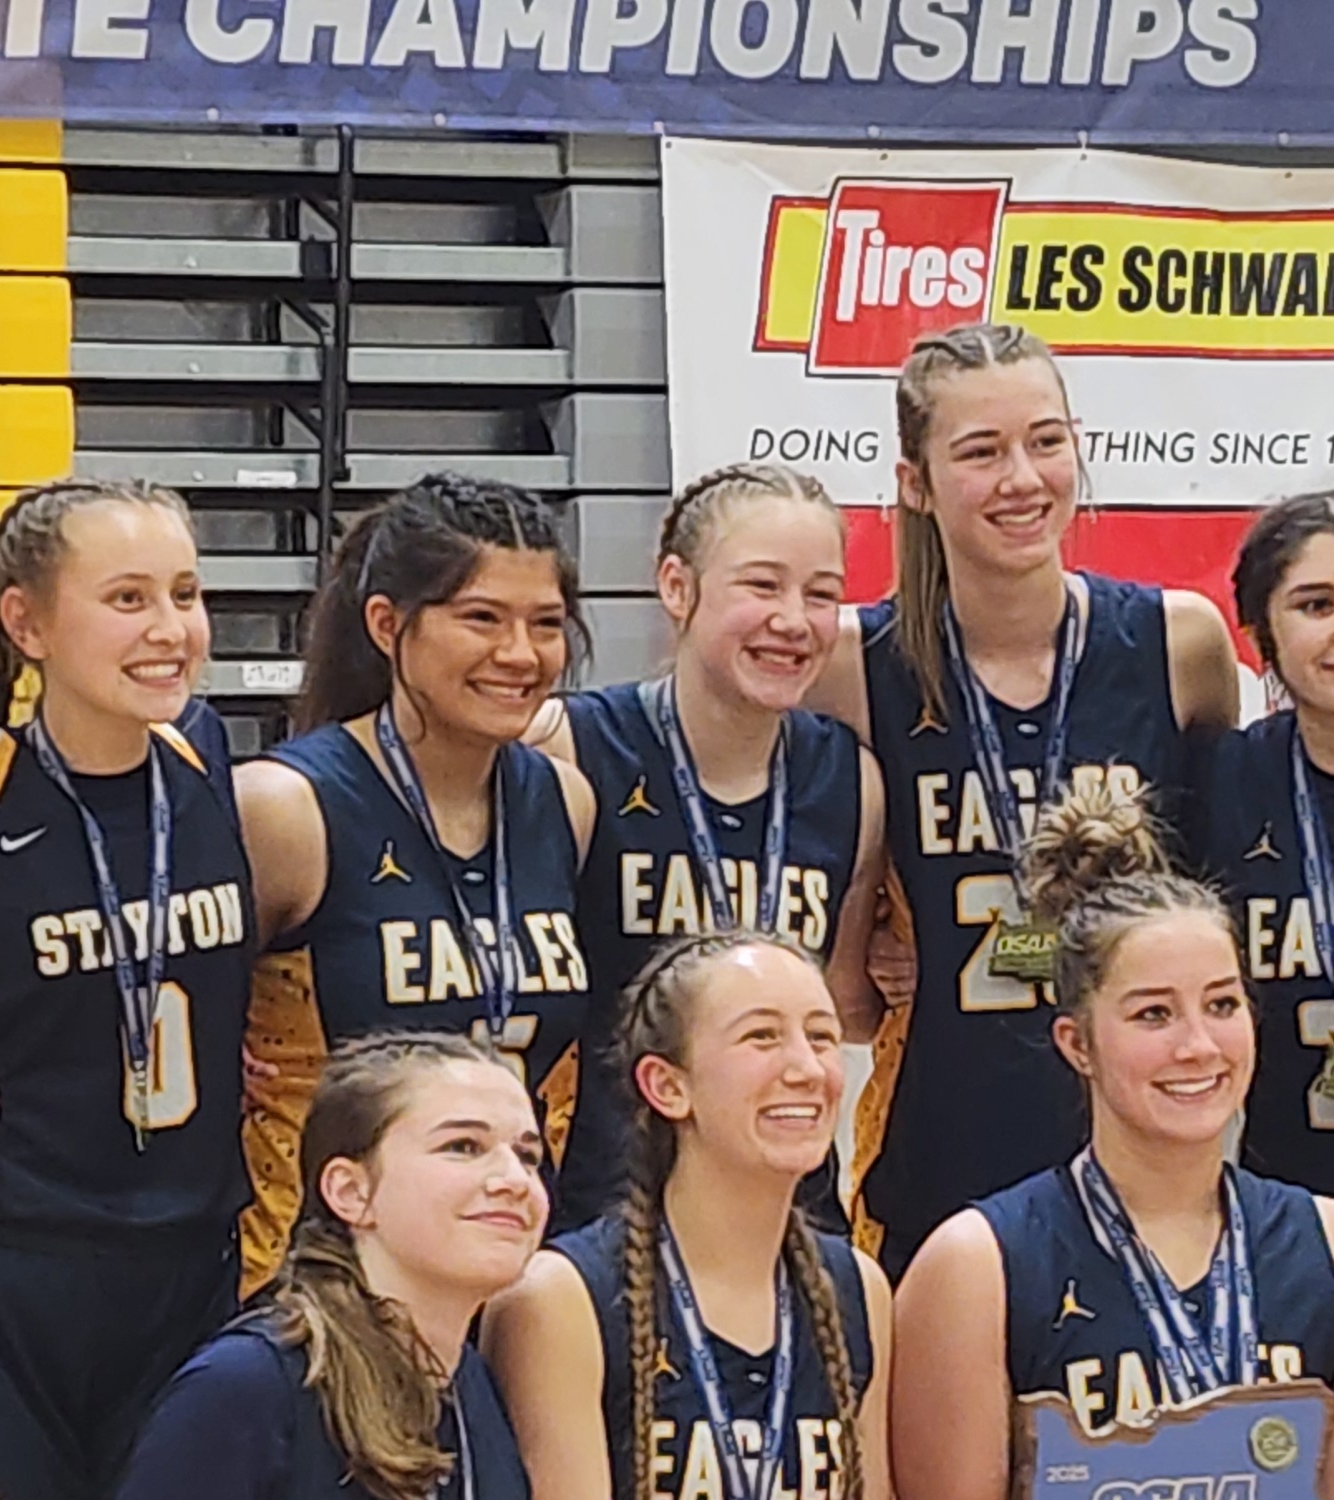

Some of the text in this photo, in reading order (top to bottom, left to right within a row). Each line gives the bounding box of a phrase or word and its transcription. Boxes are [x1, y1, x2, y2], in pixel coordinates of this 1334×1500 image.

[185, 0, 1258, 88] CHAMPIONSHIPS
[835, 209, 984, 322] Tires
[1005, 244, 1105, 312] LES
[749, 429, 879, 463] DOING
[1208, 432, 1311, 465] SINCE
[30, 882, 244, 977] STYTON
